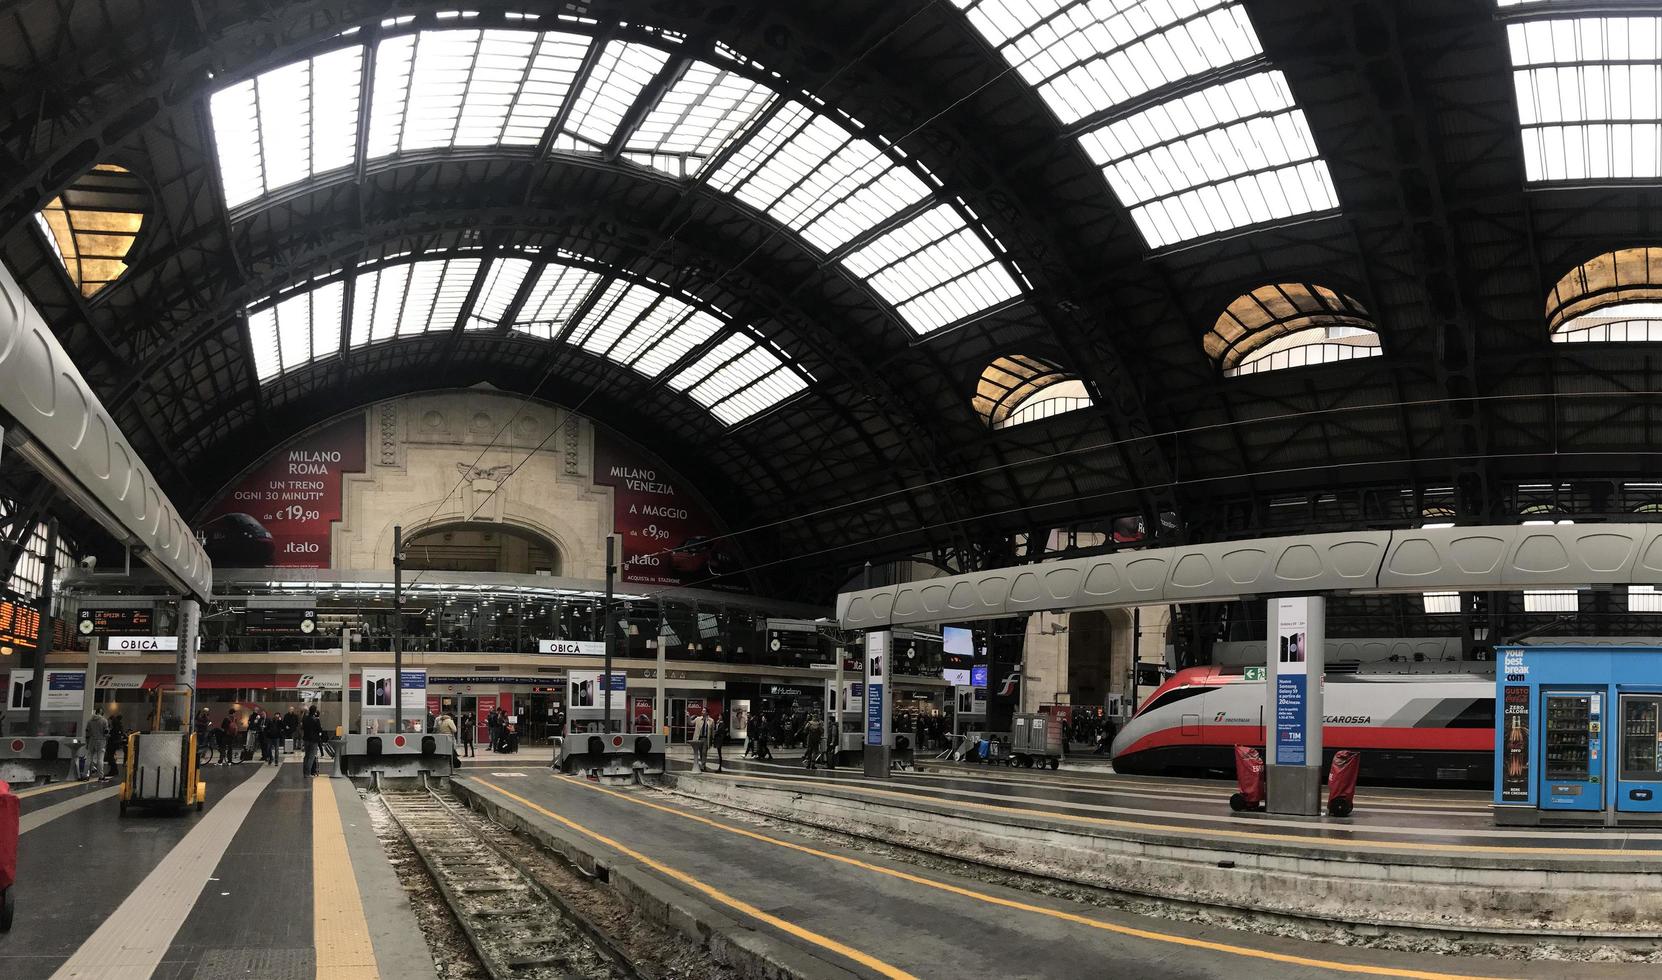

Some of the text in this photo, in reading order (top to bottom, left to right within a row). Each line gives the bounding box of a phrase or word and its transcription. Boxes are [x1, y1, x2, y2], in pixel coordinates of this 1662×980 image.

[288, 451, 341, 463] MILANO
[288, 464, 329, 475] ROMA
[610, 466, 656, 481] MILANO
[269, 481, 325, 490] UN TRENO
[626, 479, 674, 496] VENEZIA
[234, 491, 262, 500] OGNI
[265, 491, 279, 500] 30
[629, 504, 688, 520] A MAGGIO
[627, 574, 650, 583] ACQUISTA
[658, 576, 681, 585] STAZIONE
[304, 610, 314, 618] 20
[120, 637, 159, 649] OBICÀ
[550, 642, 581, 653] OBICÀ
[1505, 650, 1524, 658] your
[1505, 657, 1523, 666] best
[1504, 666, 1529, 674] break
